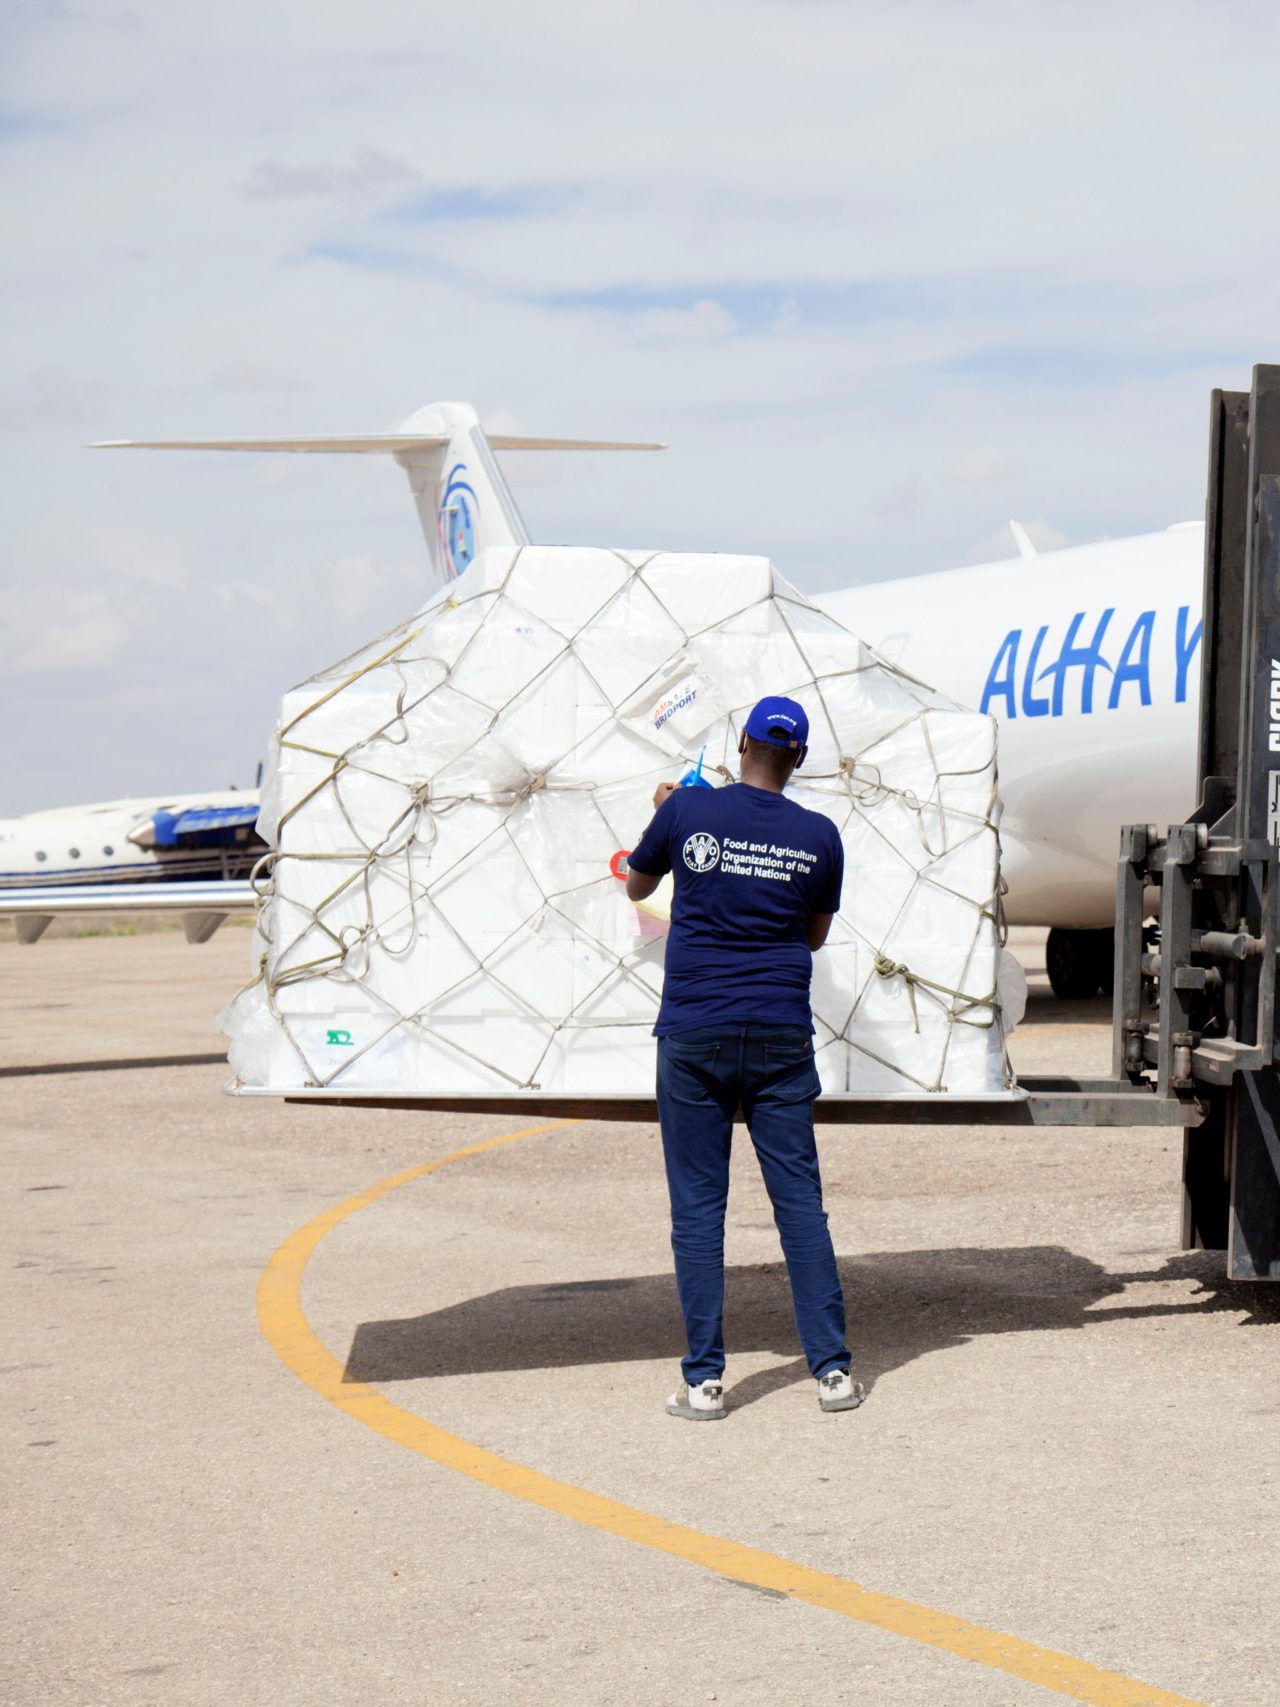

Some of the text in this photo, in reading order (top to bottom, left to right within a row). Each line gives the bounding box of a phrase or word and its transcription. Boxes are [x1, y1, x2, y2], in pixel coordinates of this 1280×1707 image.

[654, 690, 697, 730] BRIDPORT
[722, 850, 811, 874] Organization of the
[723, 838, 818, 863] Food and Agriculture
[720, 862, 791, 881] United Nations
